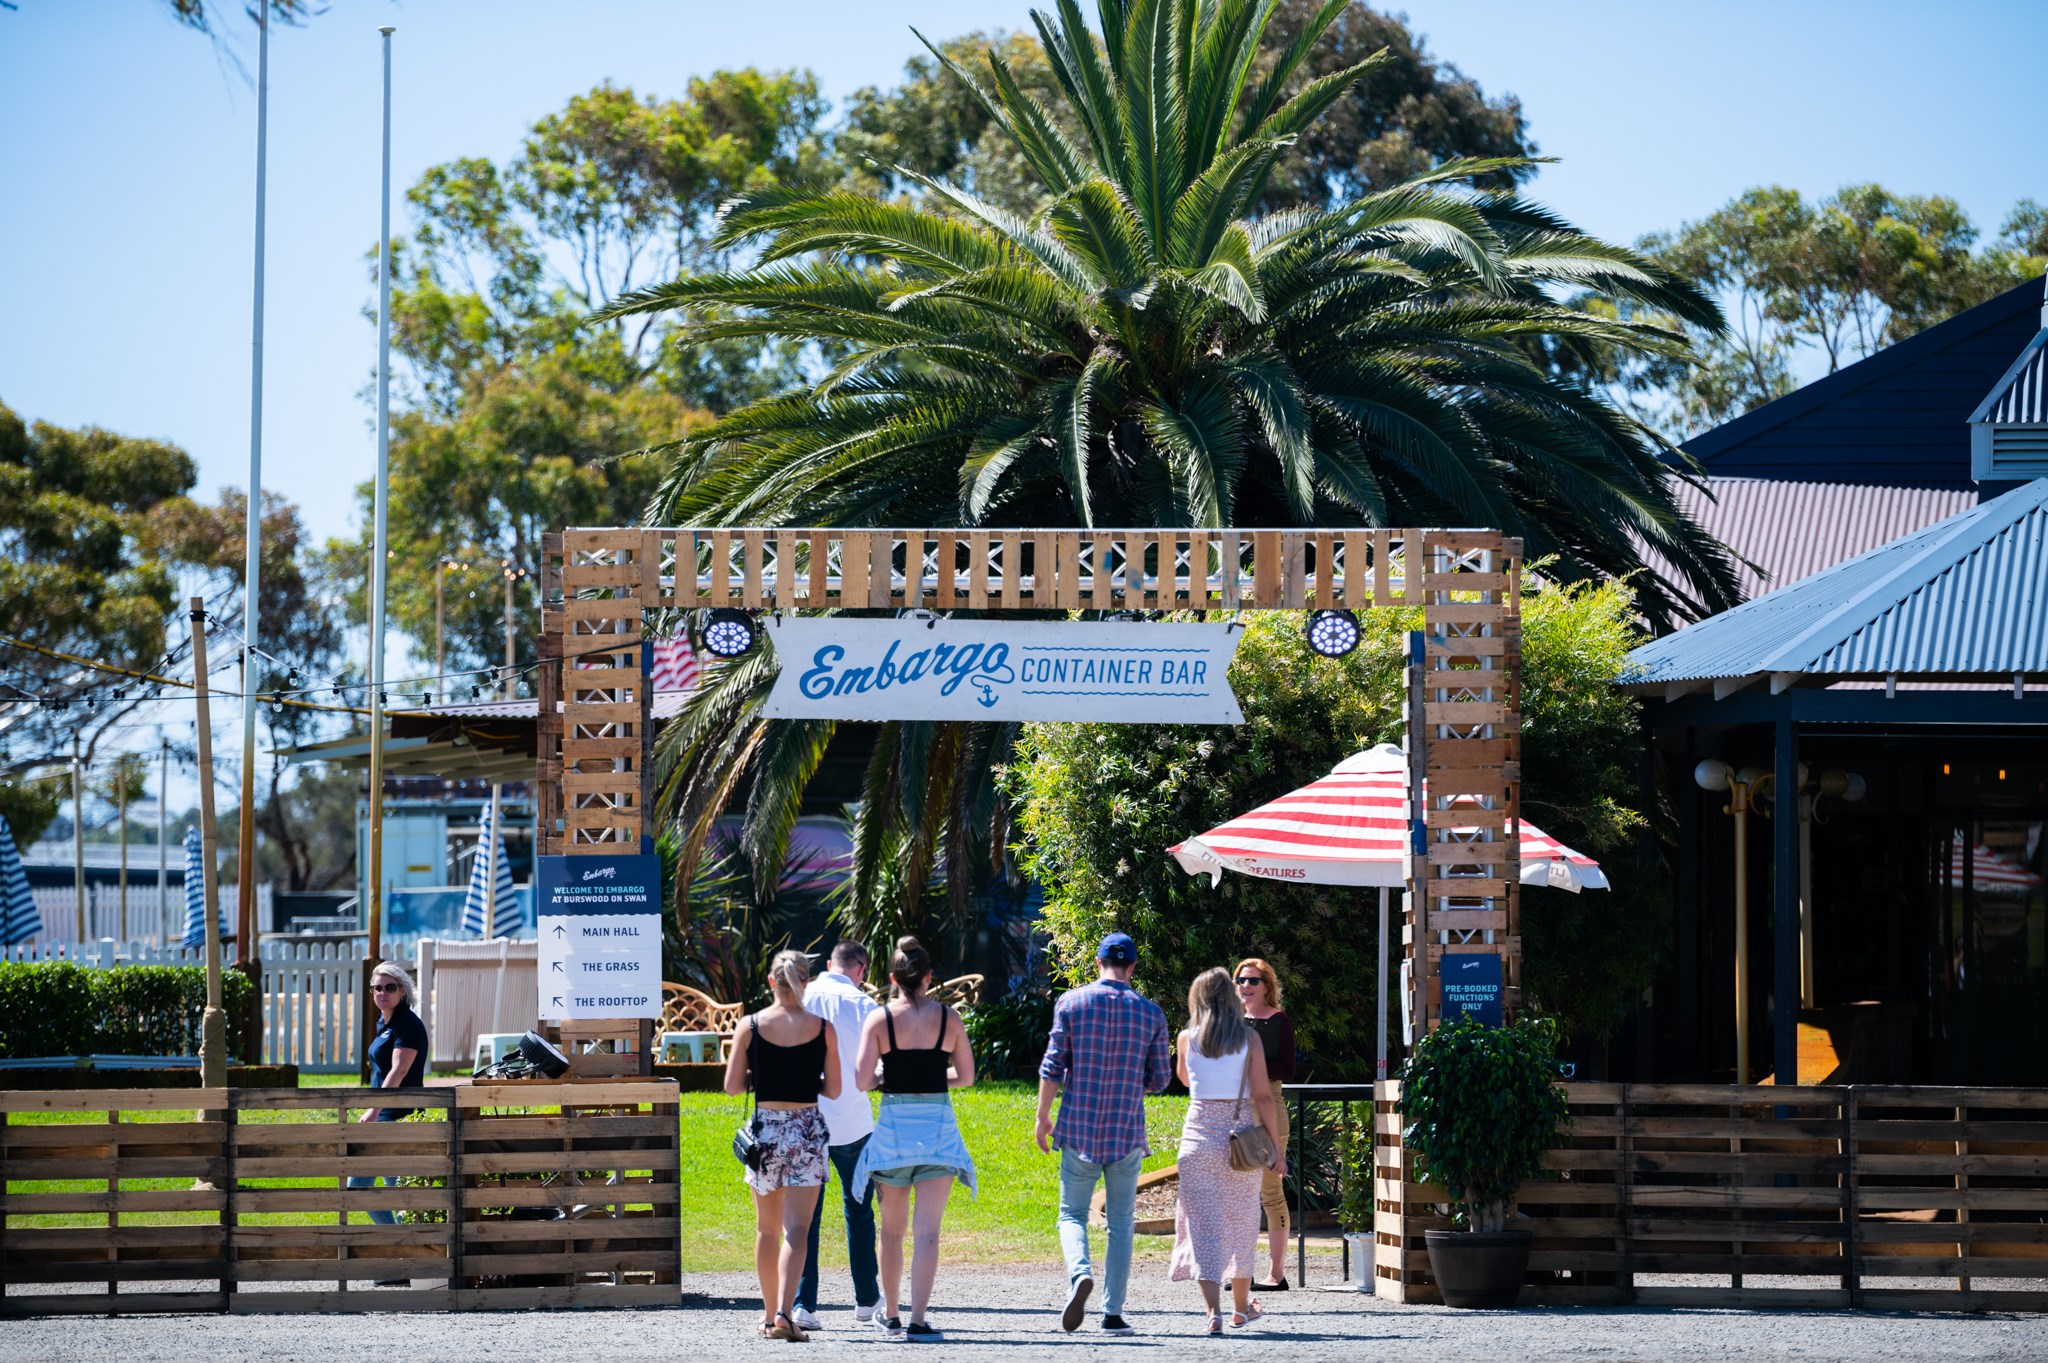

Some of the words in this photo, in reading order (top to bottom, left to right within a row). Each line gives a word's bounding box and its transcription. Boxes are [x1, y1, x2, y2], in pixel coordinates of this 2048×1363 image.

[799, 639, 1015, 699] Embargo
[1021, 657, 1153, 684] CONTAINER
[1160, 660, 1207, 685] BAR
[554, 886, 592, 894] WELCOME
[594, 886, 604, 894] TO
[606, 885, 645, 894] EMBARGO
[552, 896, 562, 904] AT
[564, 895, 609, 904] BURSWOOD
[611, 895, 622, 903] ON
[624, 894, 647, 903] SWAN
[582, 927, 610, 937] MAIN
[613, 927, 640, 936] HALL
[582, 962, 603, 972] THE
[605, 962, 640, 971] GRASS
[1445, 985, 1498, 993] PRE-BOOKED
[575, 997, 595, 1007] THE
[599, 996, 648, 1006] ROOFTOP
[1449, 993, 1495, 1002] FUNCTIONS
[1461, 1002, 1483, 1011] ONLY
